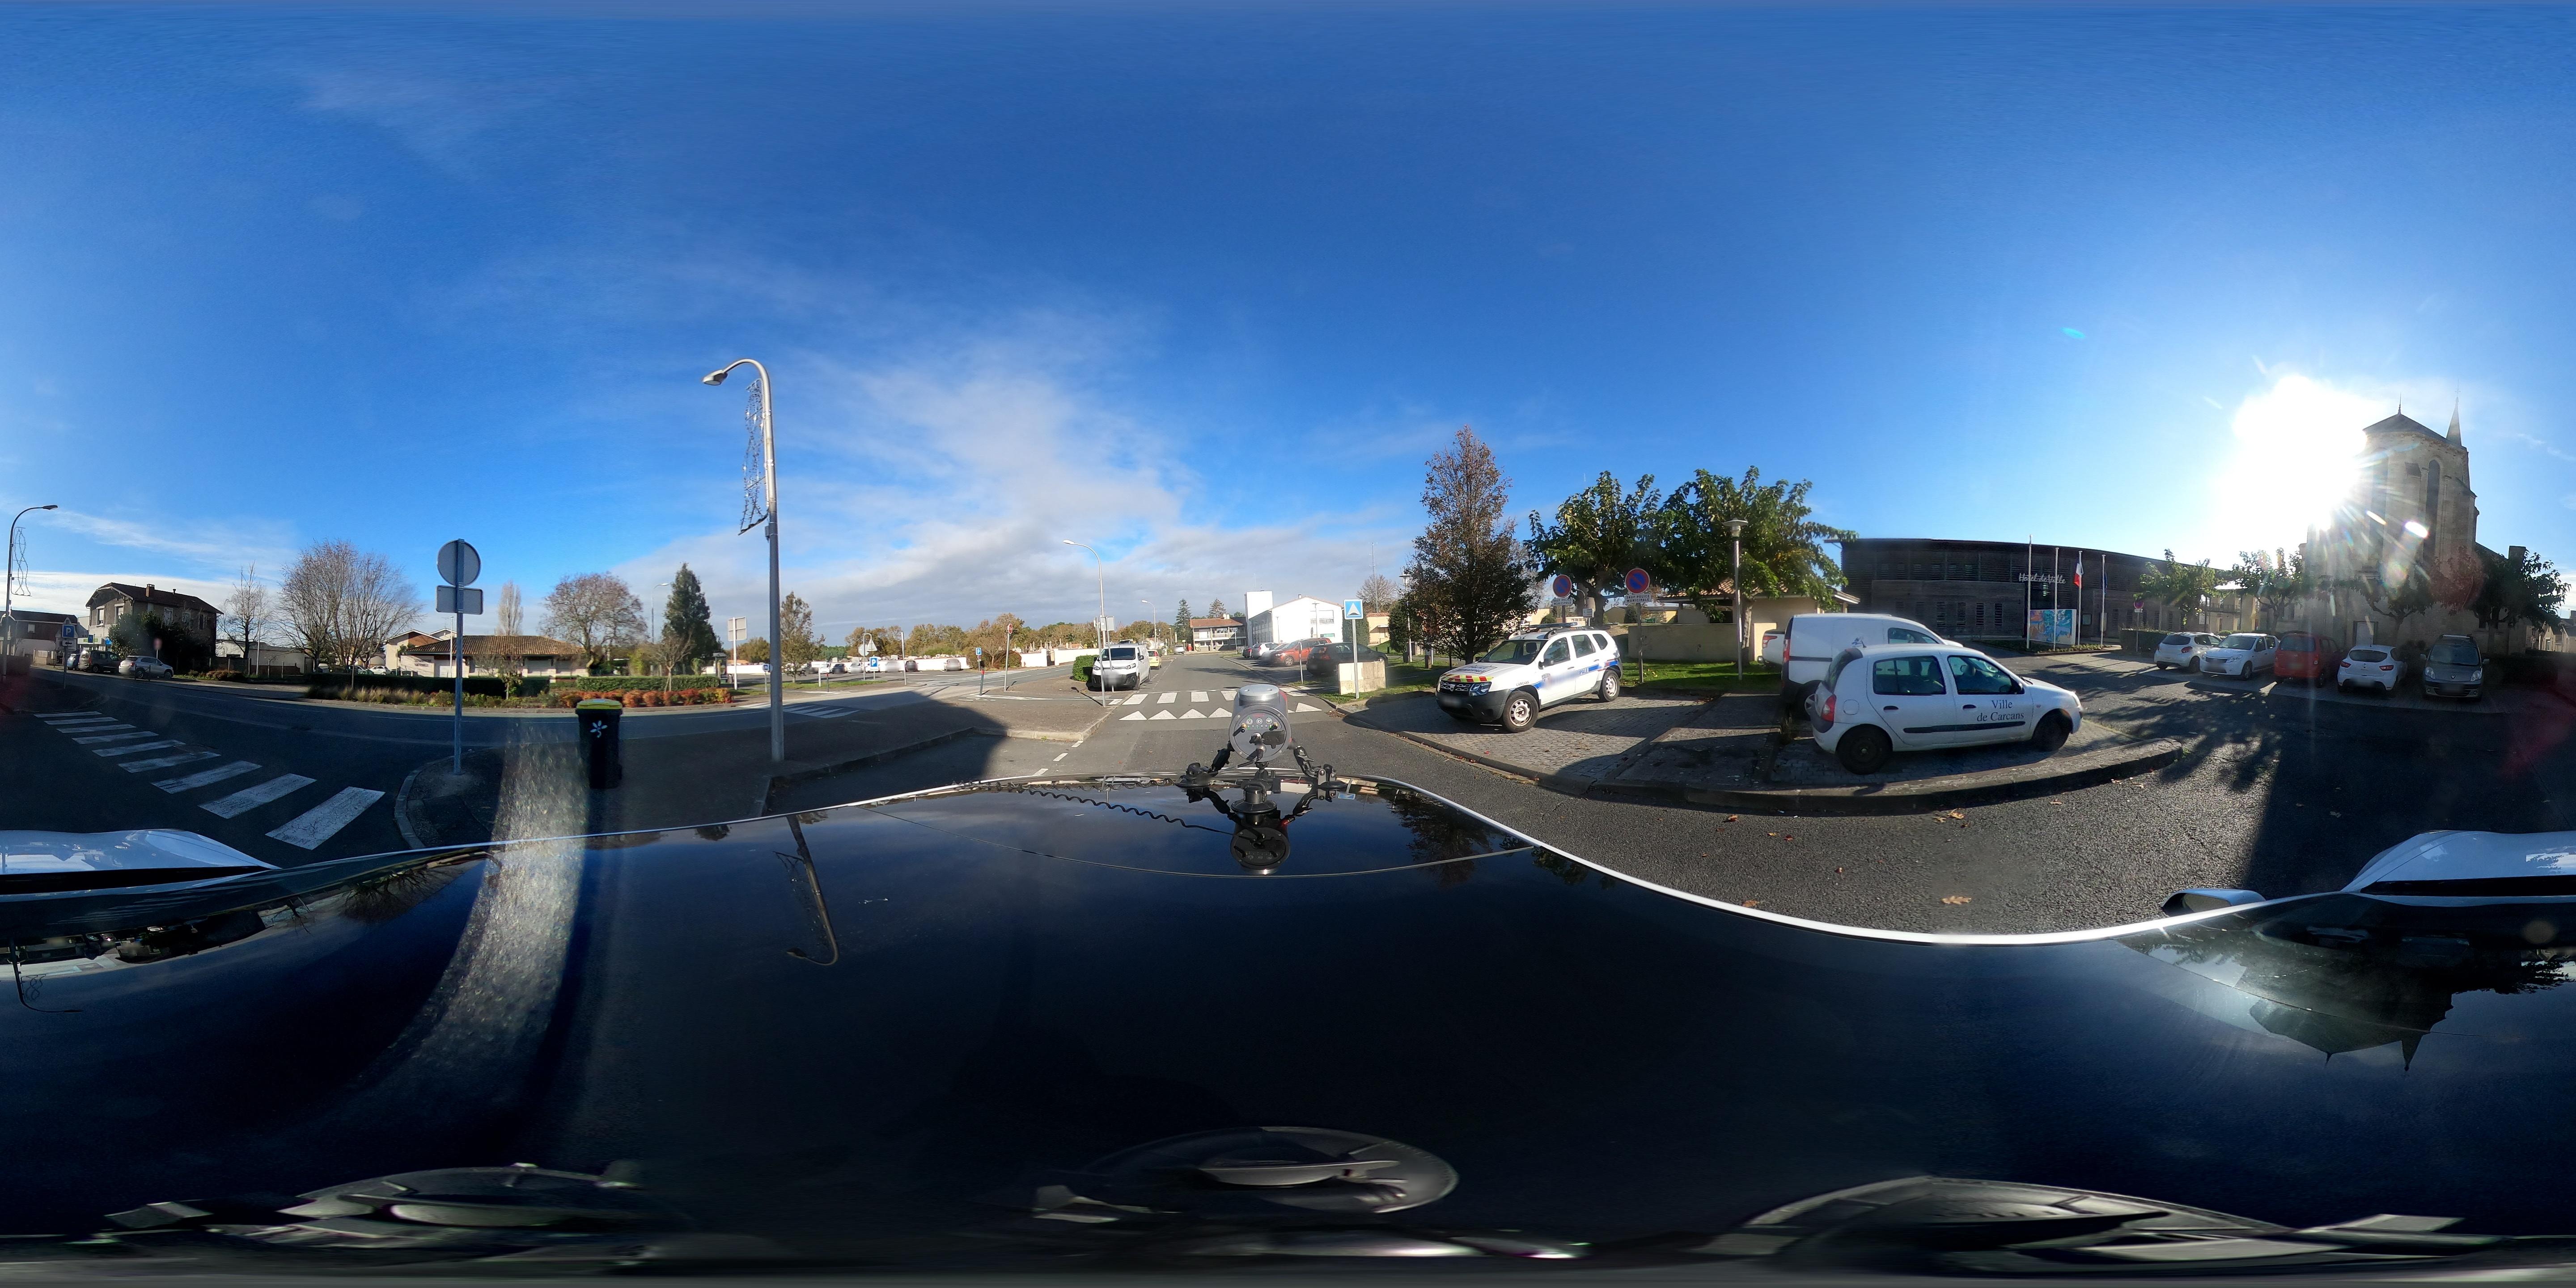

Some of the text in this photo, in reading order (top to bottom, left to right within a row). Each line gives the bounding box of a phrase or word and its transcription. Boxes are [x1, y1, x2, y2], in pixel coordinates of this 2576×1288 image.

[2048, 574, 2066, 584] Ville
[1991, 699, 2012, 709] Ville
[1977, 712, 2024, 721] de Carcans
